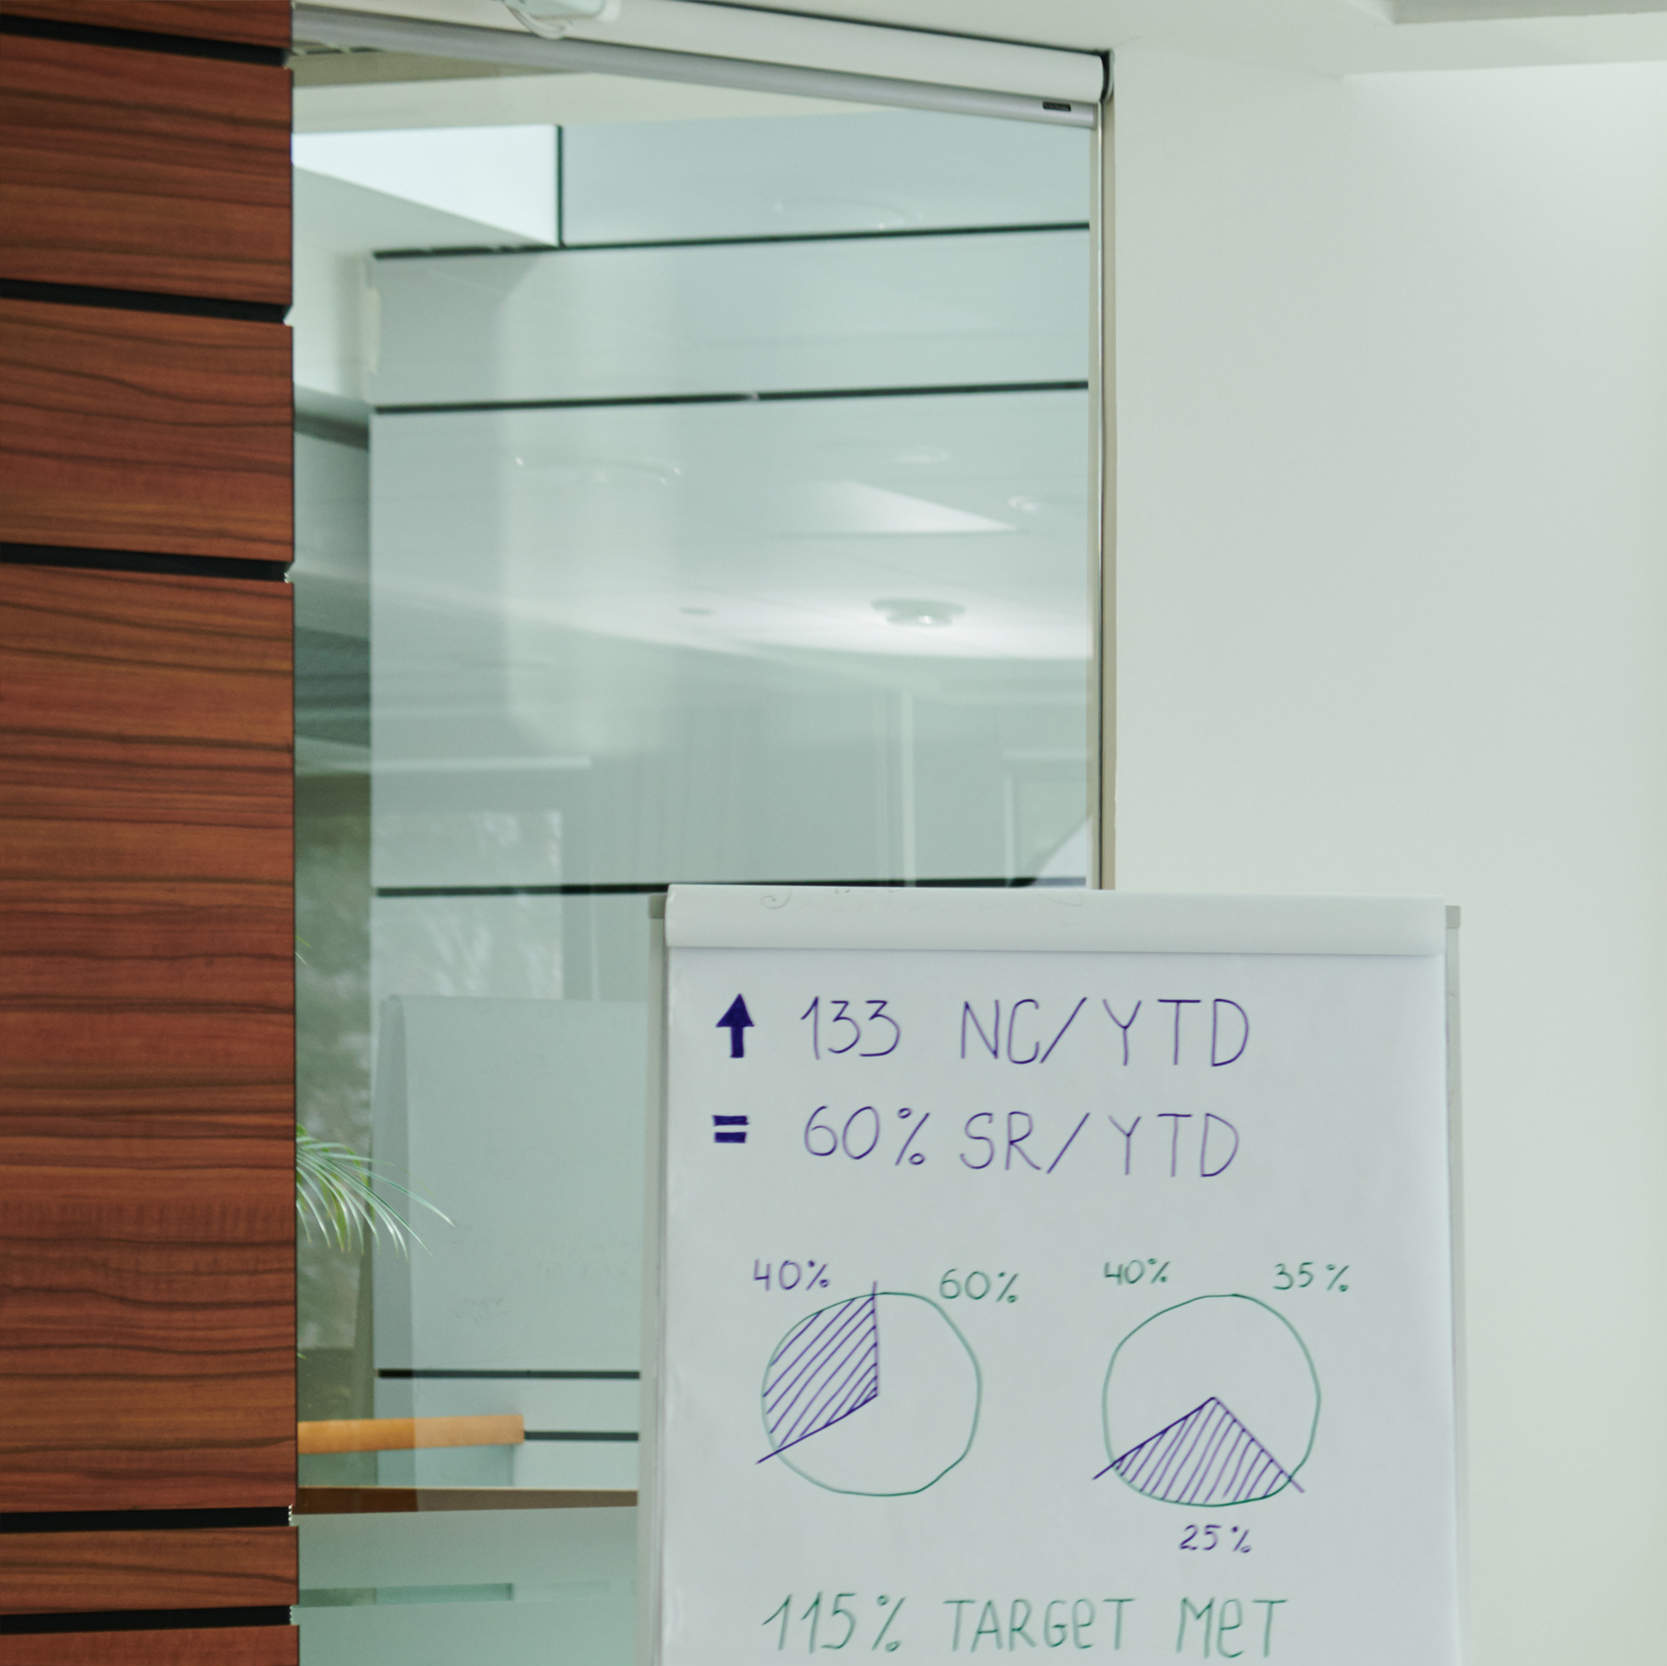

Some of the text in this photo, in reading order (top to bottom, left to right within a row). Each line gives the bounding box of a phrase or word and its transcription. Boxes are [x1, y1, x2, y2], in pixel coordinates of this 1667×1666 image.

[800, 995, 1250, 1068] 133 NC/YTD
[803, 1105, 931, 1166] 60%
[959, 1110, 1239, 1178] SR/YTD
[753, 1259, 830, 1291] 40%
[938, 1268, 1019, 1304] 60%
[1103, 1257, 1171, 1286] 40%
[1273, 1261, 1350, 1293] 35%
[1178, 1523, 1252, 1554] 25%
[762, 1591, 906, 1654] 115%
